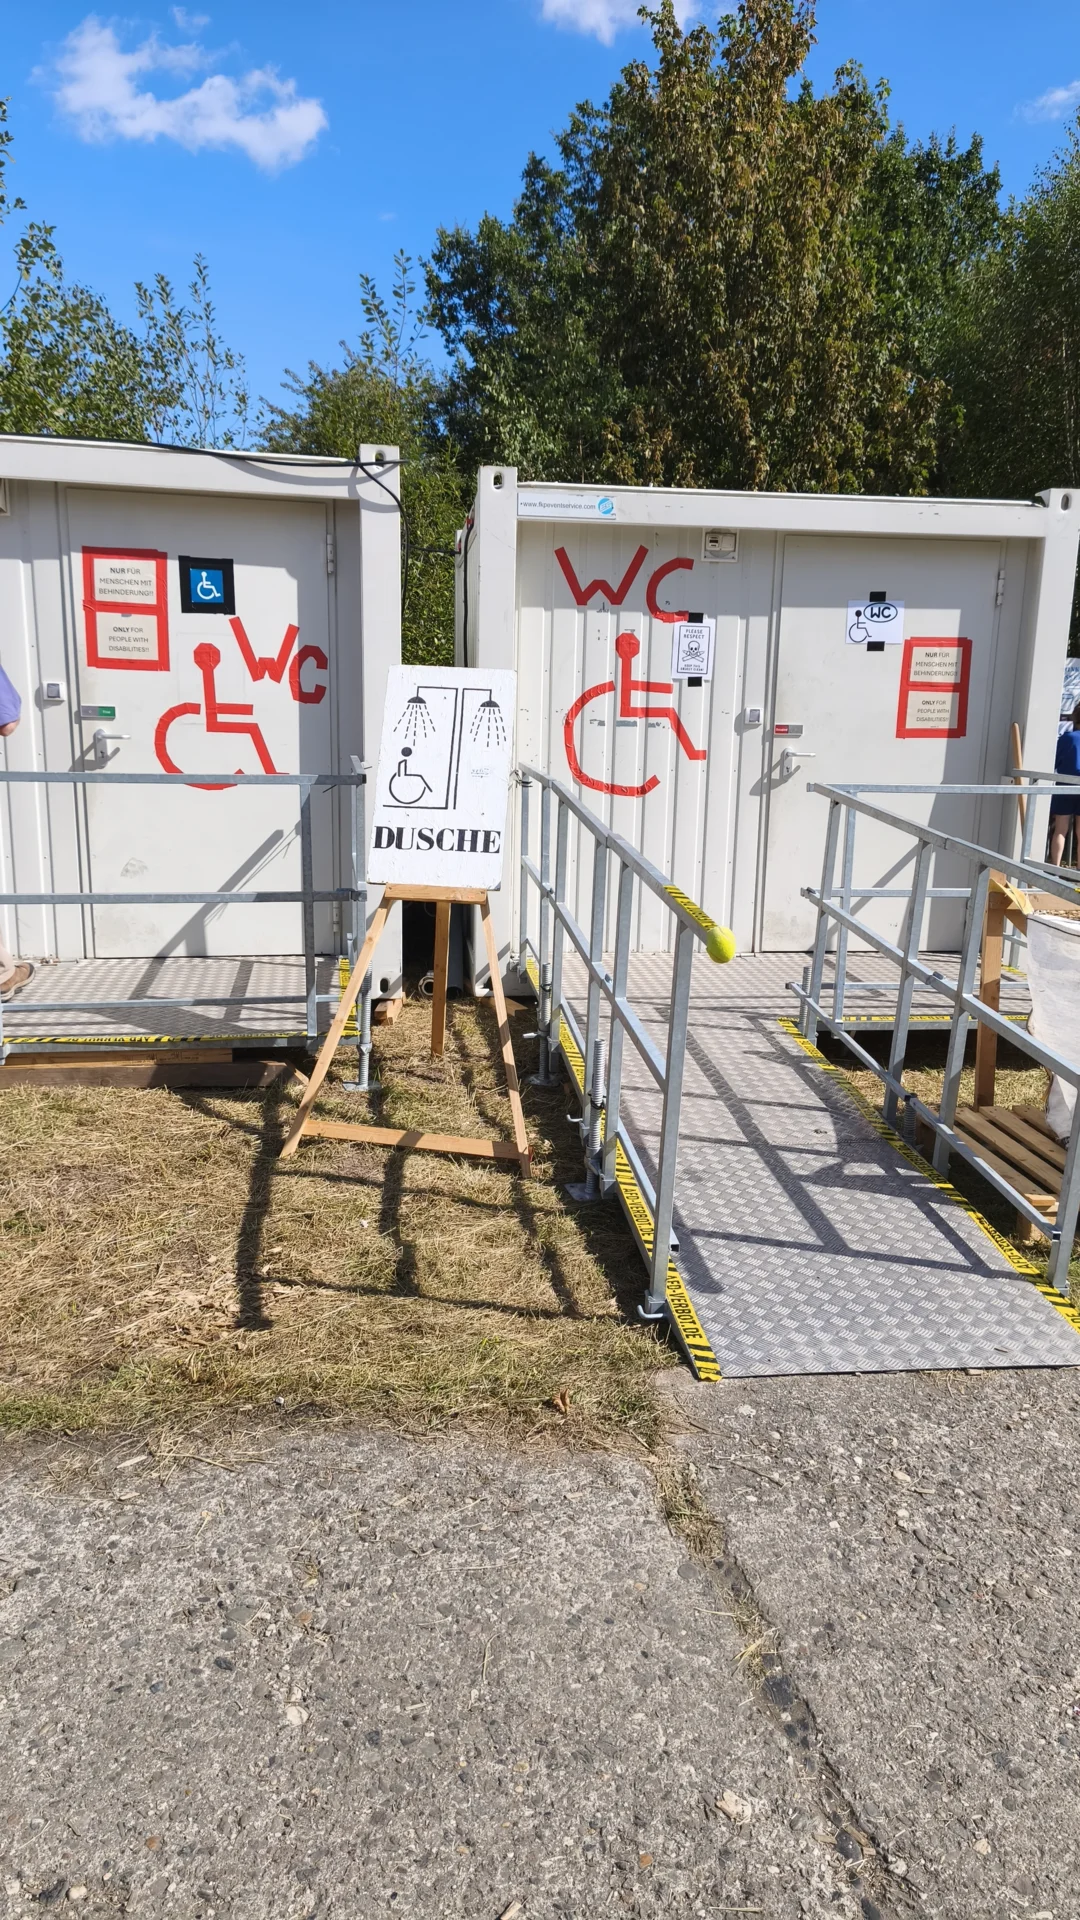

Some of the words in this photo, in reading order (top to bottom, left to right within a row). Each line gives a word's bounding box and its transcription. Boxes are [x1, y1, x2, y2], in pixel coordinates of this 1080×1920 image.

[126, 567, 141, 575] FÜR
[99, 578, 139, 586] MENSCHEN
[554, 545, 694, 623] WC
[98, 587, 154, 597] BEHINDERUNG!!
[870, 606, 892, 619] WC
[108, 635, 132, 643] PEOPLE
[108, 645, 150, 653] DISABILITIES!!
[228, 616, 328, 704] WC
[372, 825, 501, 854] DUSCHE
[623, 1188, 654, 1237] AFD-VERBOT.DE
[667, 1275, 702, 1340] AFD-VERBOT.DE
